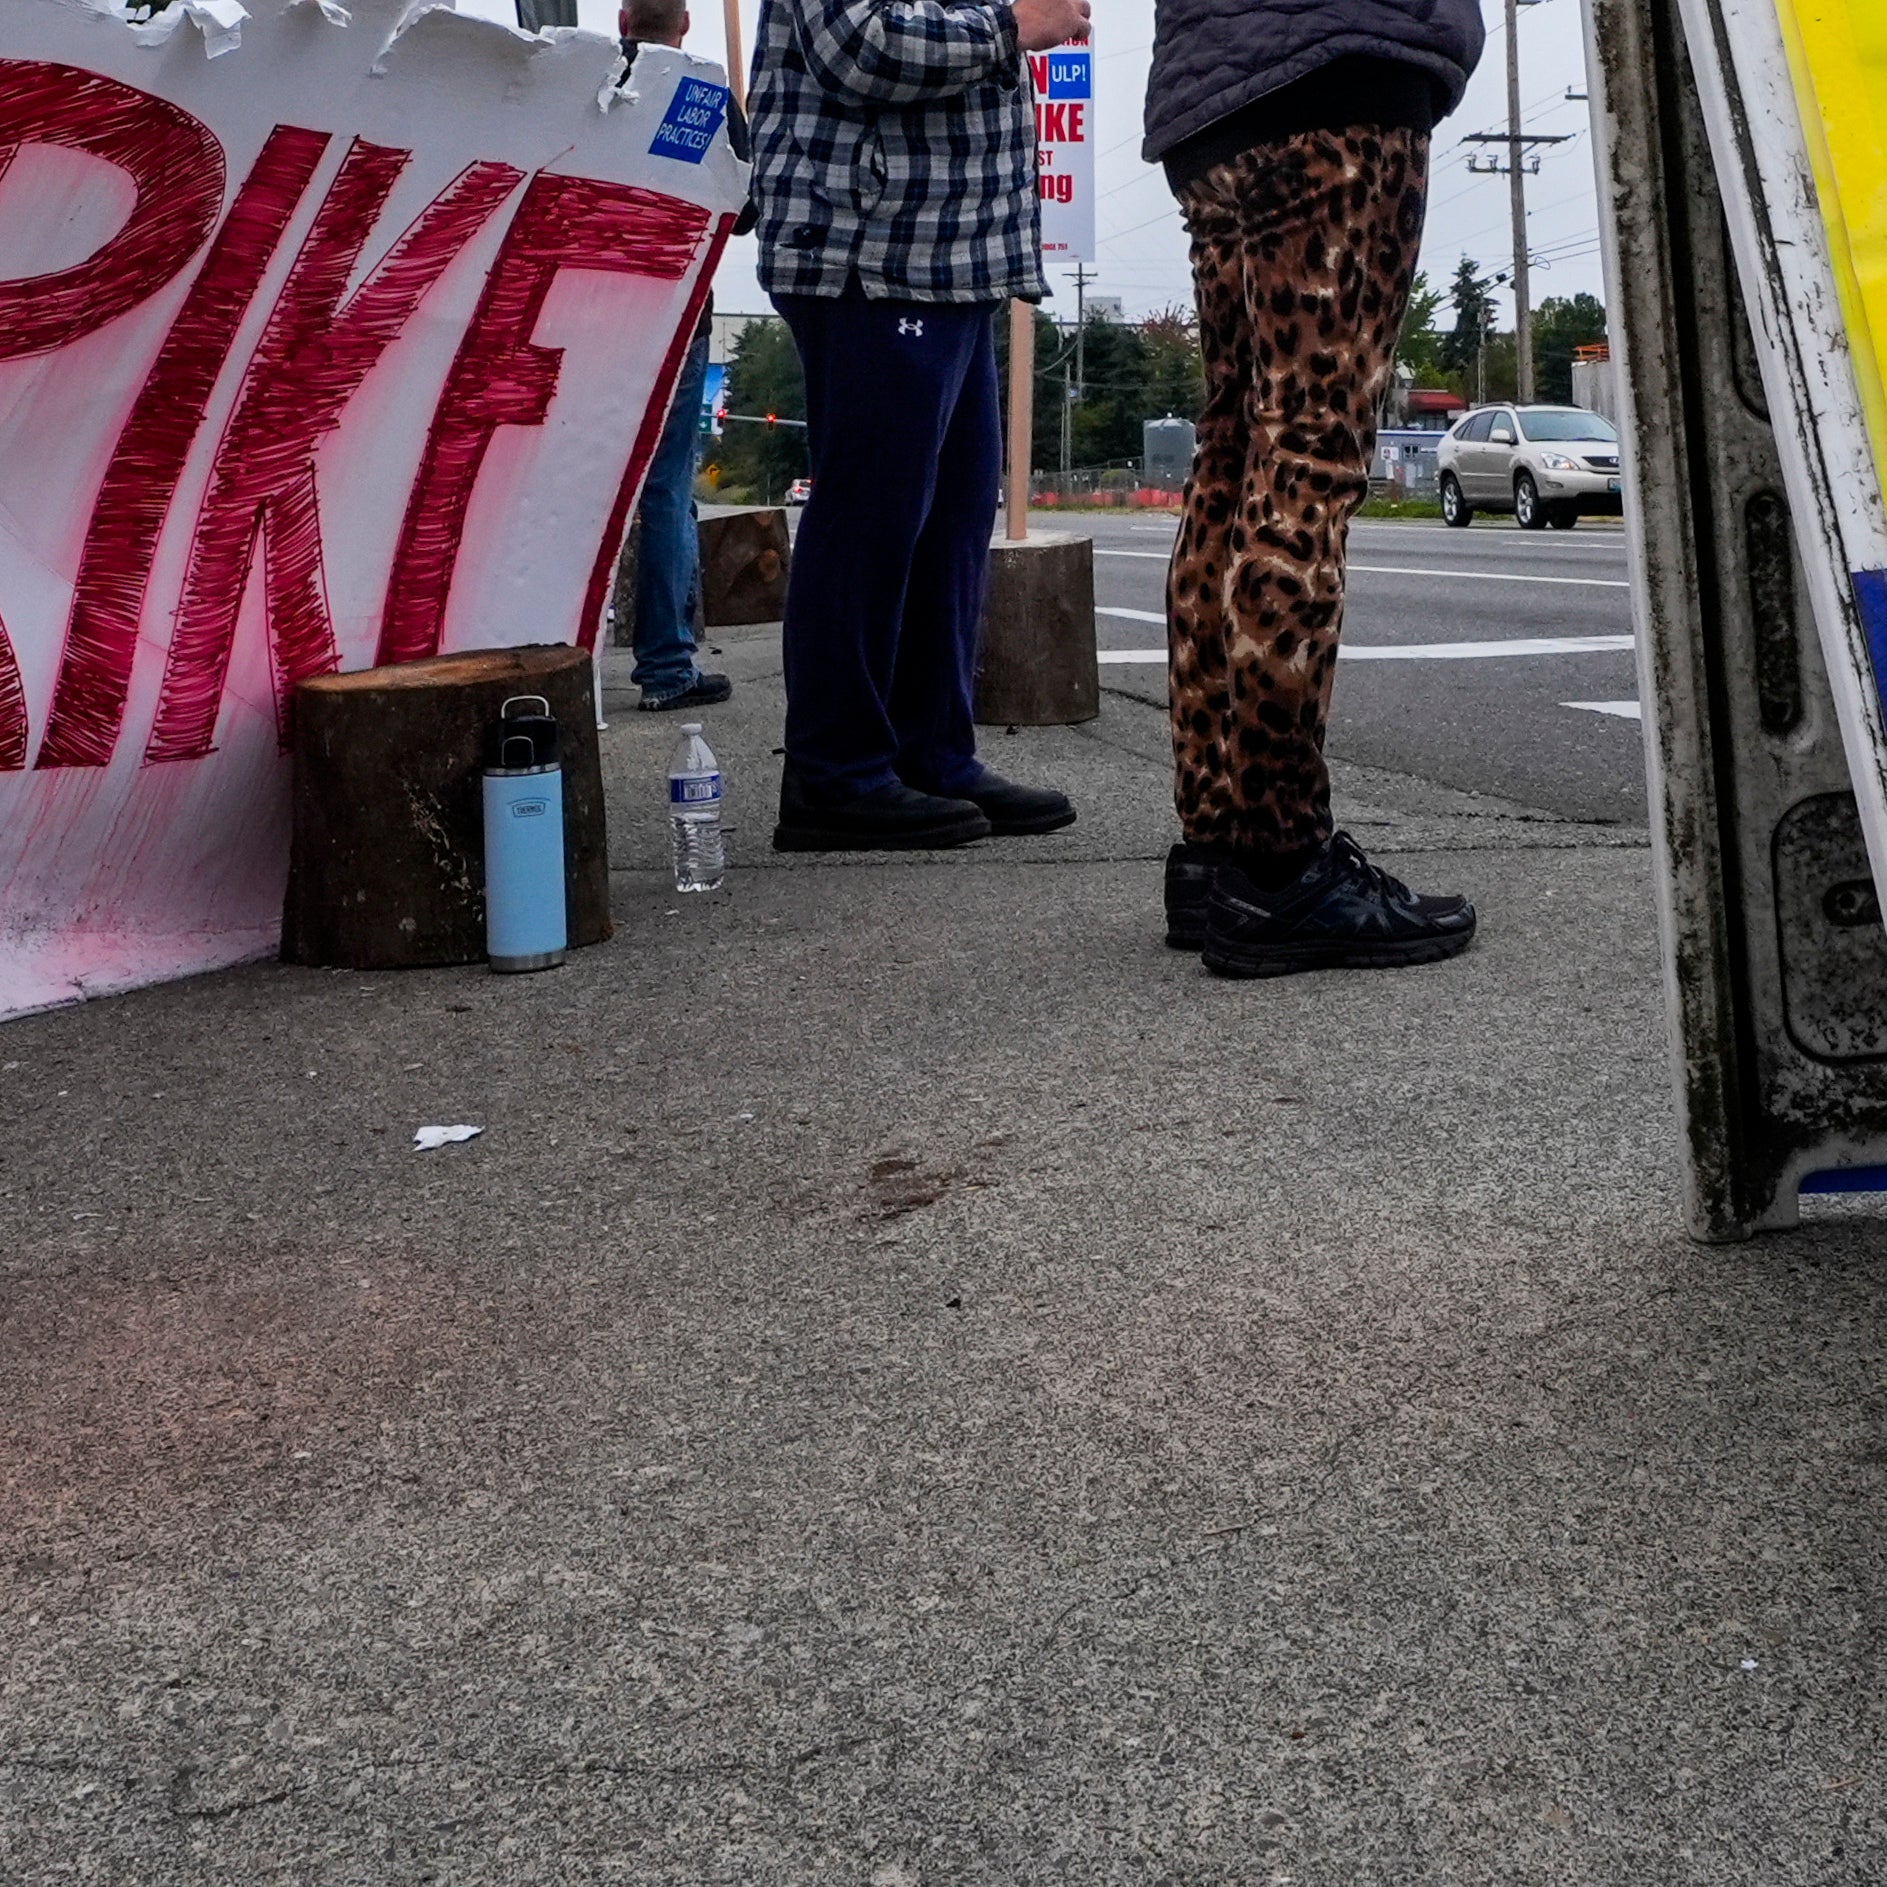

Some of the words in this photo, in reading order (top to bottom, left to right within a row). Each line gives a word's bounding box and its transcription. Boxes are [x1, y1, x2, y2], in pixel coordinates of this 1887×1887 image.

[1052, 64, 1086, 82] ULP!
[685, 84, 722, 108] UNFAIR
[677, 105, 711, 127] LABOR
[656, 122, 712, 150] PRACTICES!
